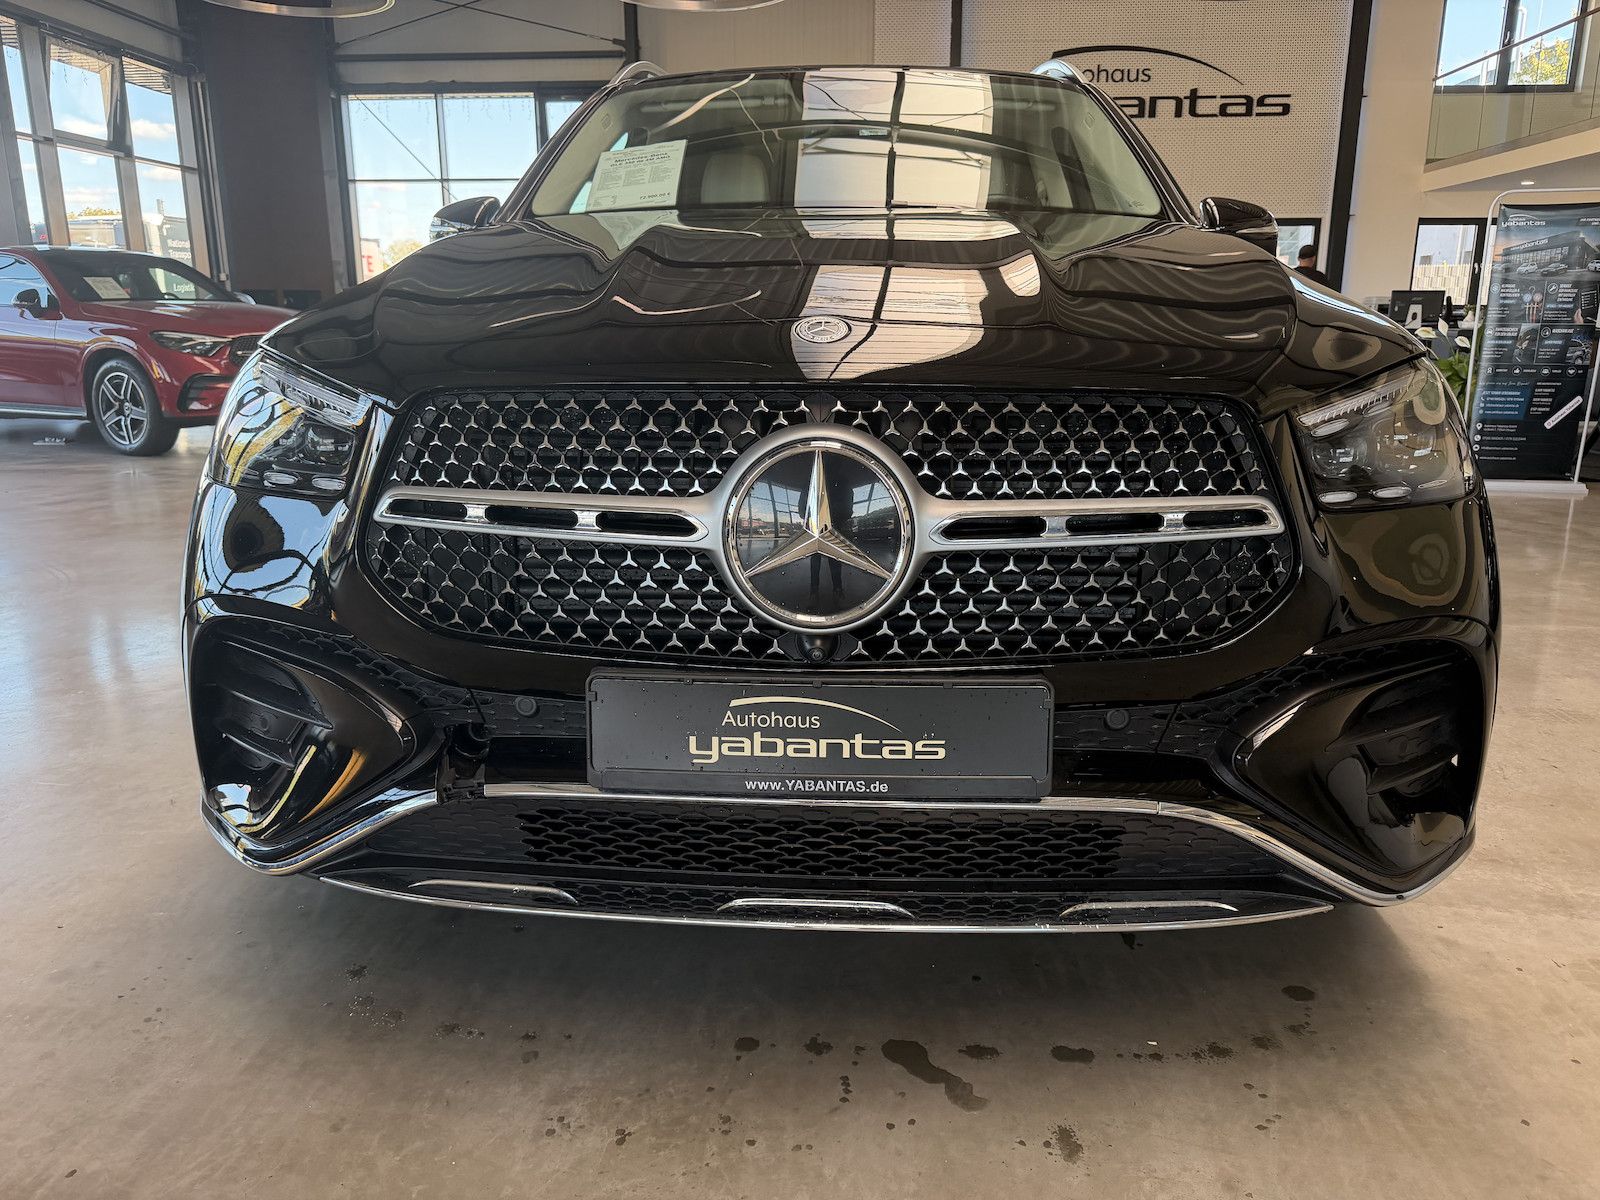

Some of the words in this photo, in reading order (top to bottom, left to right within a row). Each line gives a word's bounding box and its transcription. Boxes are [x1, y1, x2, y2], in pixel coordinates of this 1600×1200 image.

[1082, 65, 1152, 83] ohaus
[1112, 88, 1292, 119] antas
[721, 711, 821, 730] Autohaus
[688, 731, 947, 765] yabantas
[744, 779, 889, 794] www.YABANTAS.de
